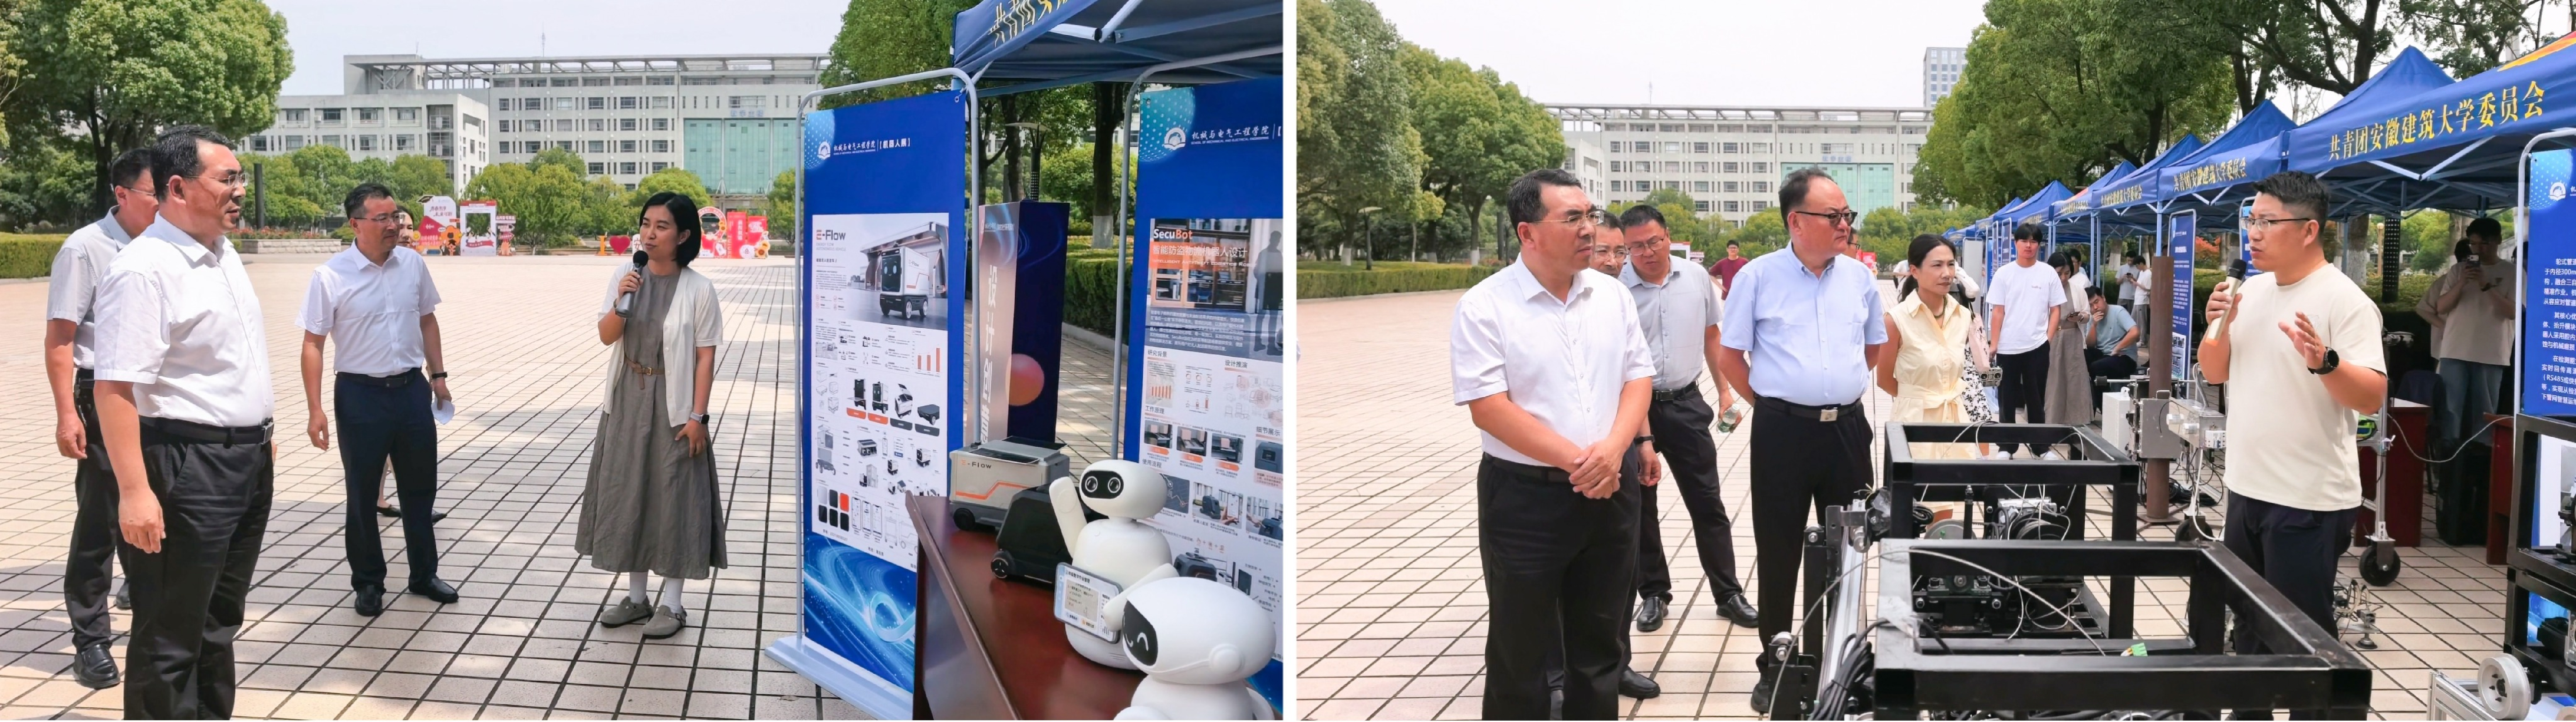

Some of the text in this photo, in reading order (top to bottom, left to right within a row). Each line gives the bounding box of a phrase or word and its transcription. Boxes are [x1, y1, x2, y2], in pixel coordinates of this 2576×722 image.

[988, 0, 1068, 48] 共青团
[2327, 80, 2545, 161] 共青团安徽建筑大学委员会
[1192, 125, 1269, 140] 机械与电气工程学院
[816, 229, 846, 240] E-Flow
[1153, 229, 1193, 240] SecuBot
[1153, 245, 1247, 258] 智能防盗物流机器人设计
[1147, 349, 1167, 358] 研究背景
[1225, 359, 1248, 369] 设计推演
[1145, 405, 1165, 414] 工作原理
[1256, 426, 1281, 436] 细节展示
[961, 460, 992, 469] E-Flow
[1142, 459, 1162, 469] 使用流程
